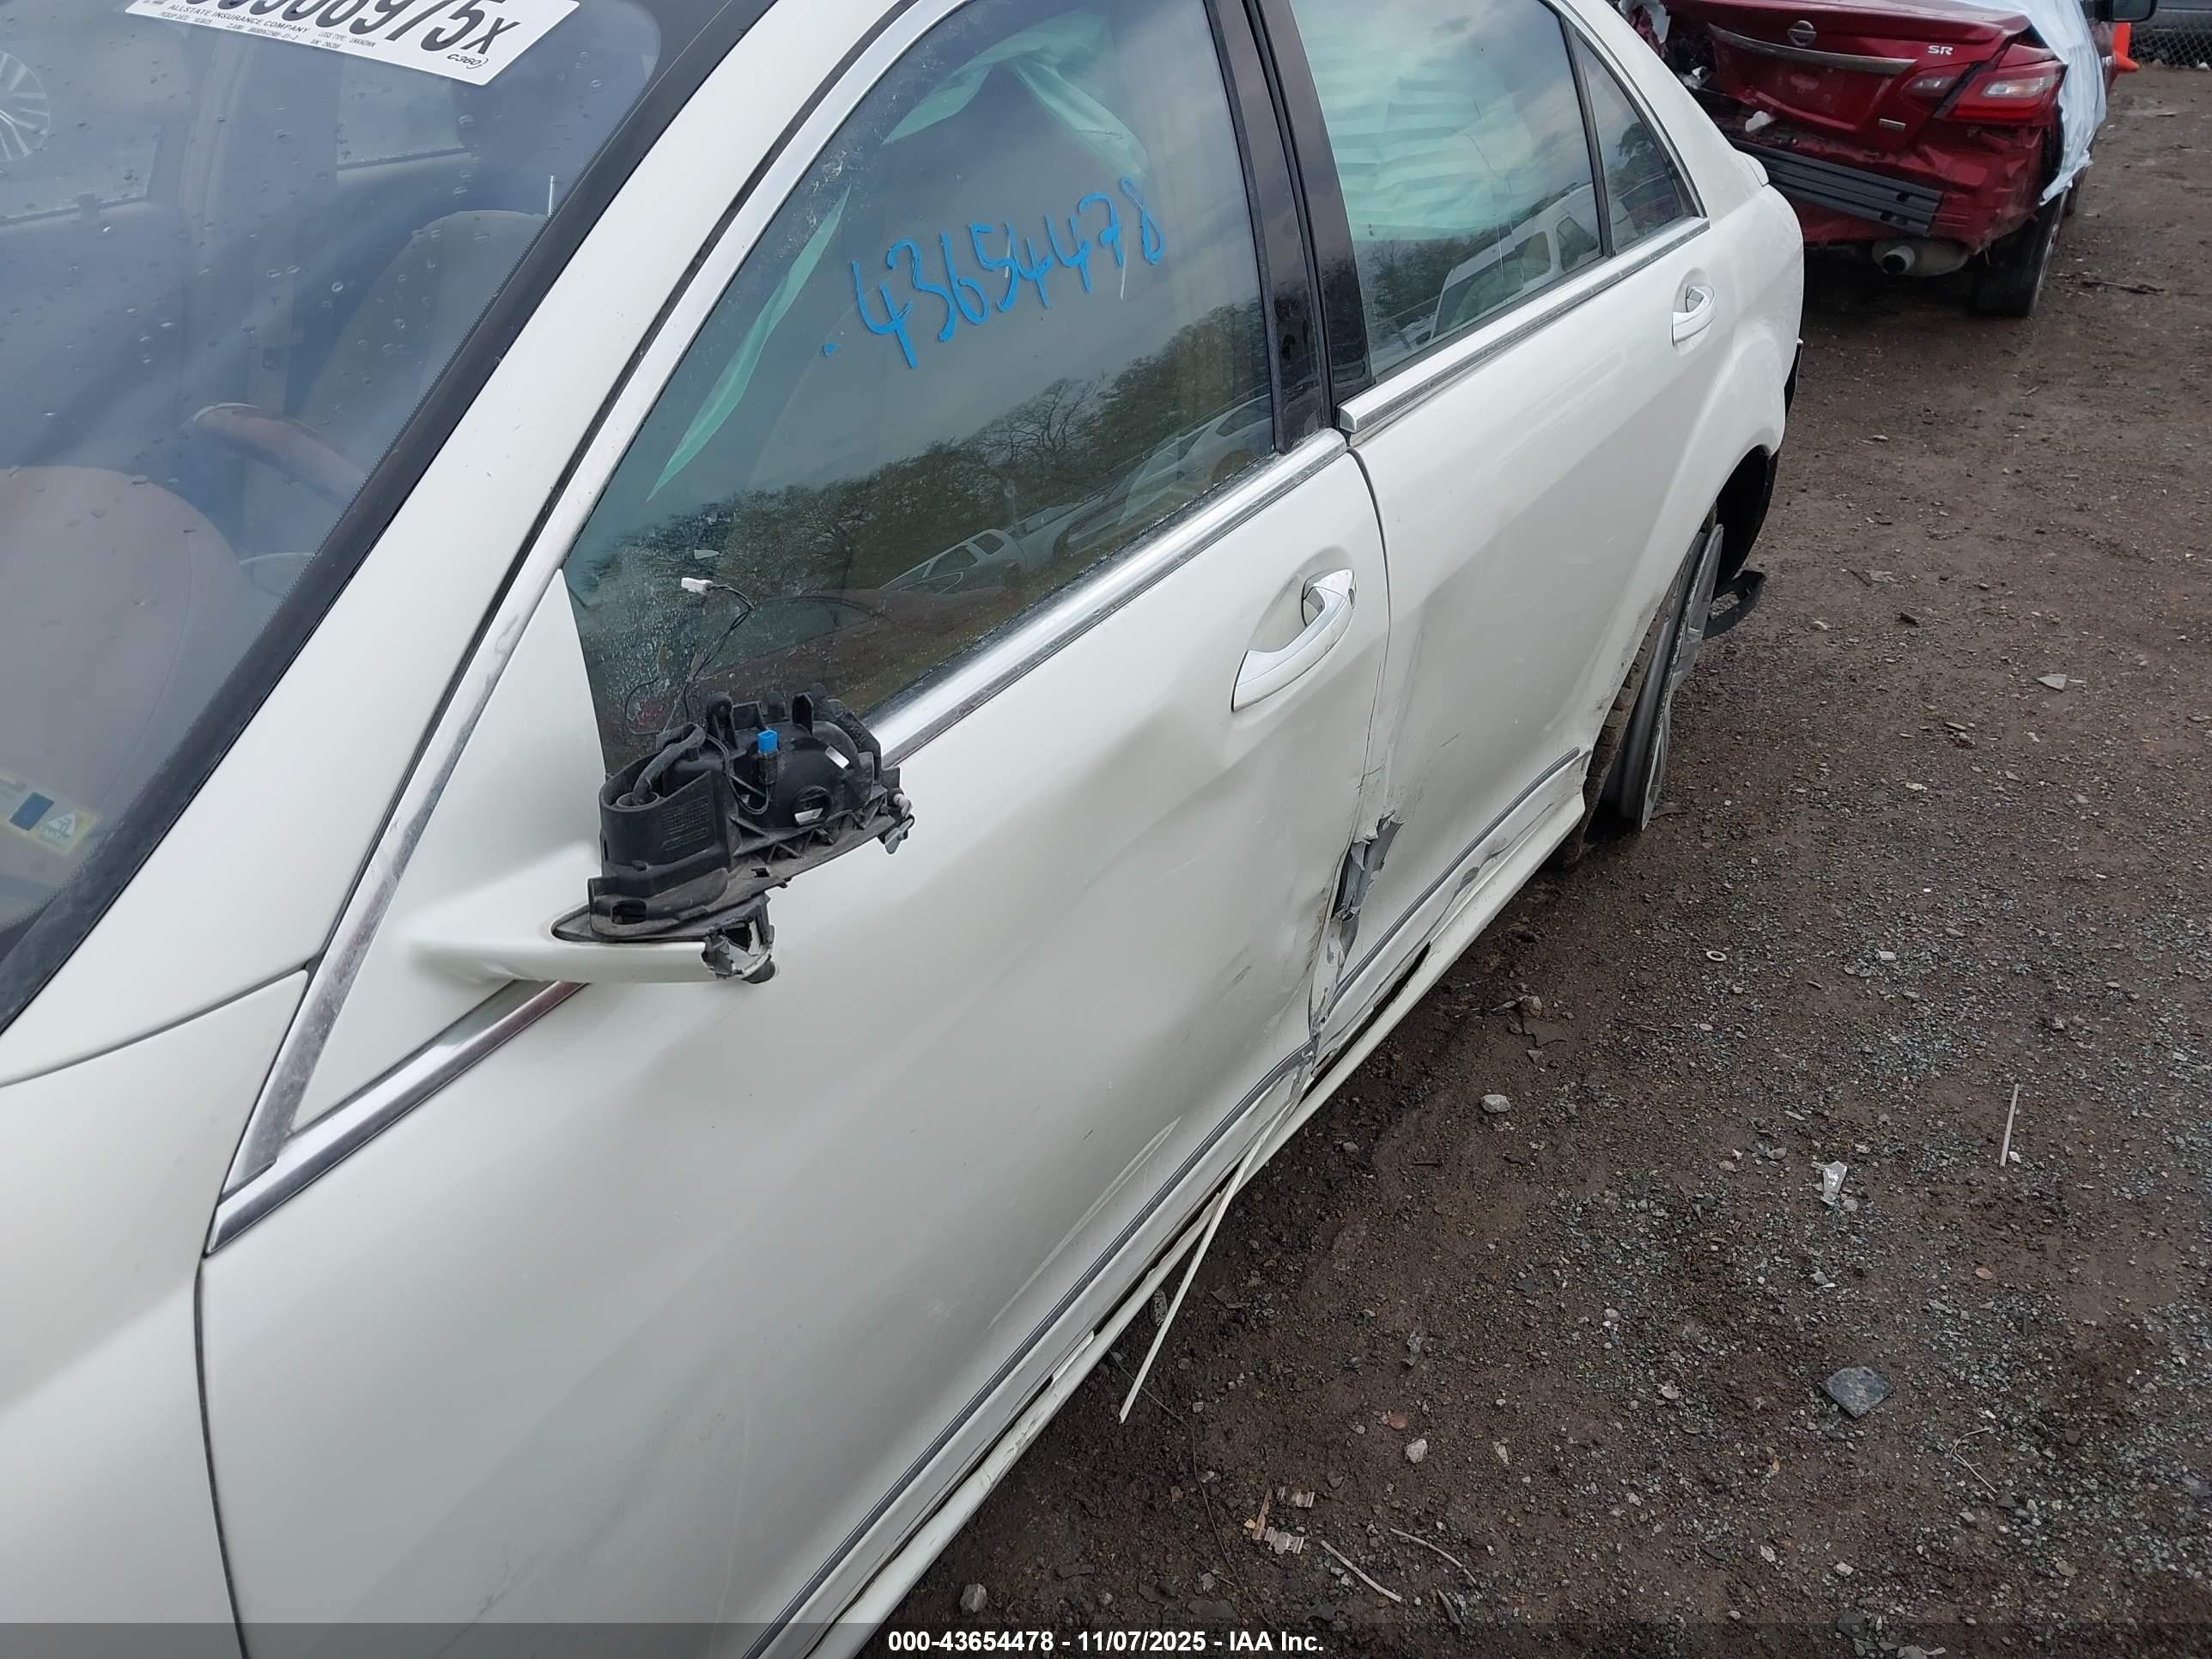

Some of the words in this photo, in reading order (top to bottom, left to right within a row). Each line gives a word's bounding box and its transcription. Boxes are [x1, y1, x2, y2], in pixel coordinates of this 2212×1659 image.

[167, 4, 212, 15] ALLSTATE
[212, 10, 264, 26] INSURANCE
[264, 20, 311, 33] COMPANY
[1927, 45, 1954, 56] SR
[851, 177, 1164, 369] 43654478
